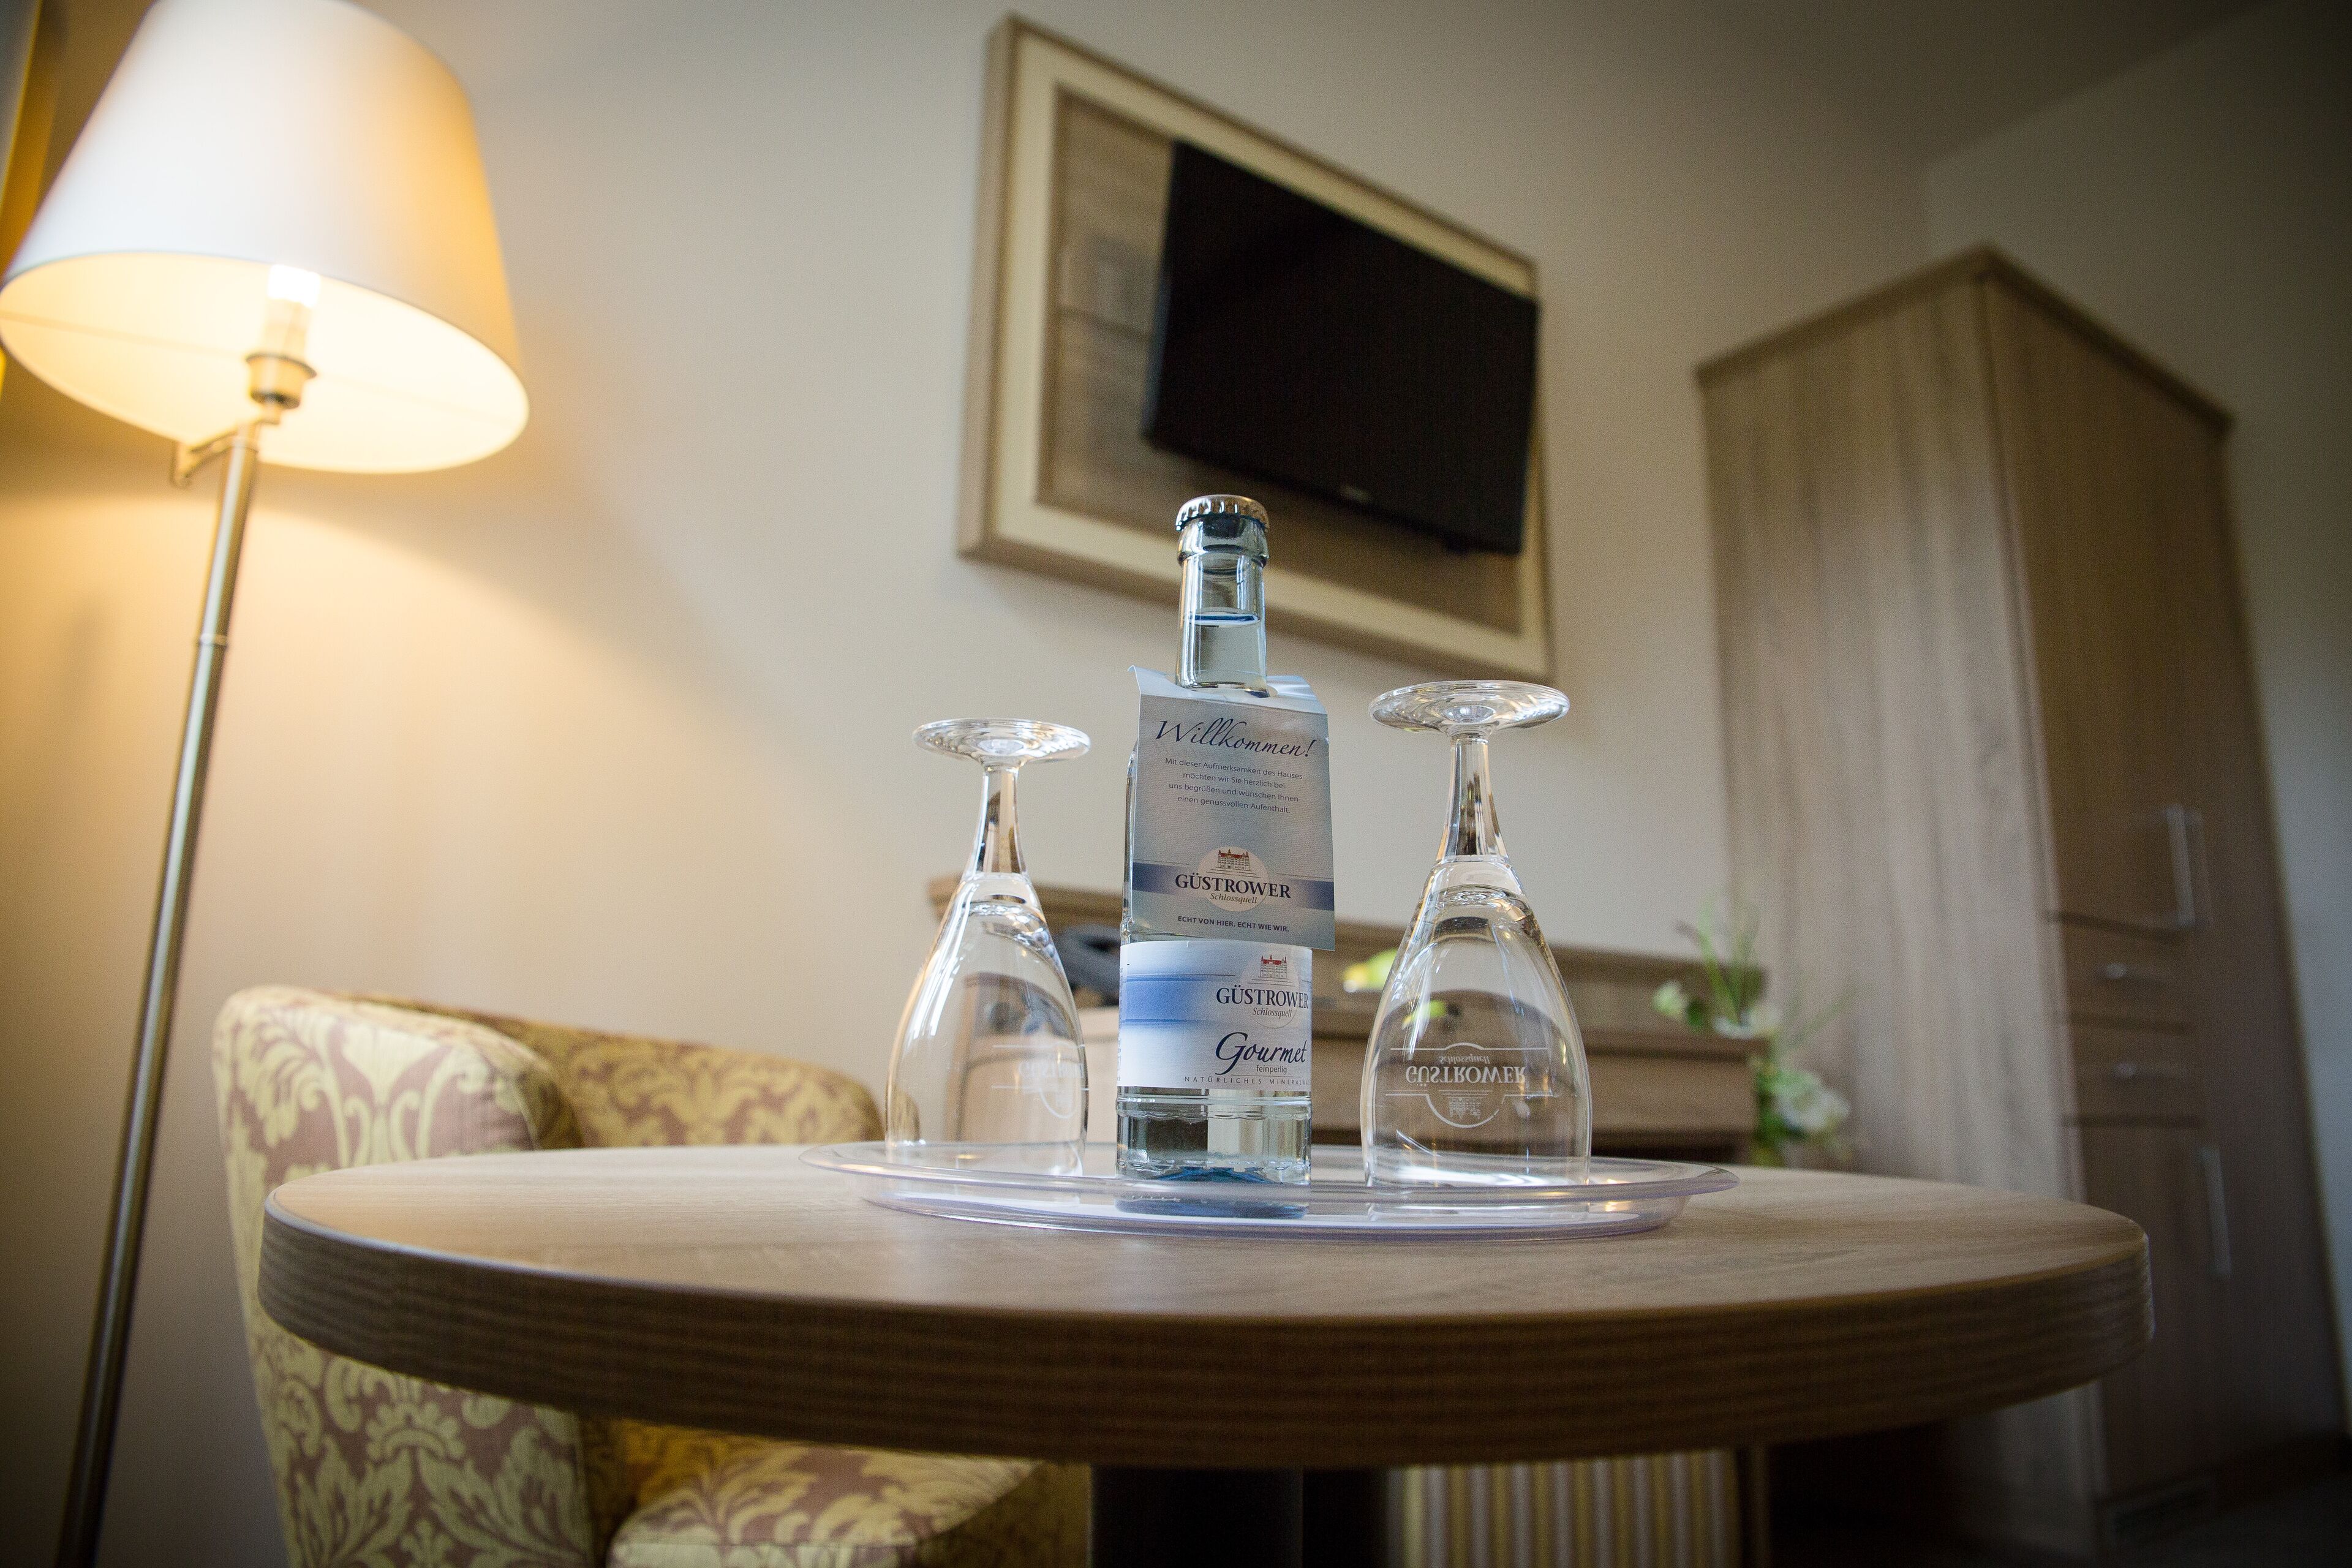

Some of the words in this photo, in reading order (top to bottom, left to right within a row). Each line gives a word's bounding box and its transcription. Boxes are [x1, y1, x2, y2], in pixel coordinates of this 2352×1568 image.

[1156, 717, 1317, 757] Willkommen!
[1203, 762, 1261, 775] Aufmerksamkeit
[1183, 772, 1216, 781] möchten
[1244, 778, 1272, 787] herzlich
[1184, 783, 1220, 794] begrüßen
[1238, 790, 1276, 800] wünschen
[1200, 799, 1248, 809] genussvollen
[1250, 803, 1291, 813] Aufenthalt.
[1175, 873, 1292, 899] GÜSTROWER
[1210, 892, 1257, 904] Schlossquell
[1216, 985, 1309, 1009] GÜSTROWER
[1252, 1007, 1292, 1019] Schlossquell
[1215, 1031, 1308, 1076] Gourmet
[1256, 1065, 1287, 1074] feinperlig
[1184, 1076, 1262, 1085] NATÜRLICHES
